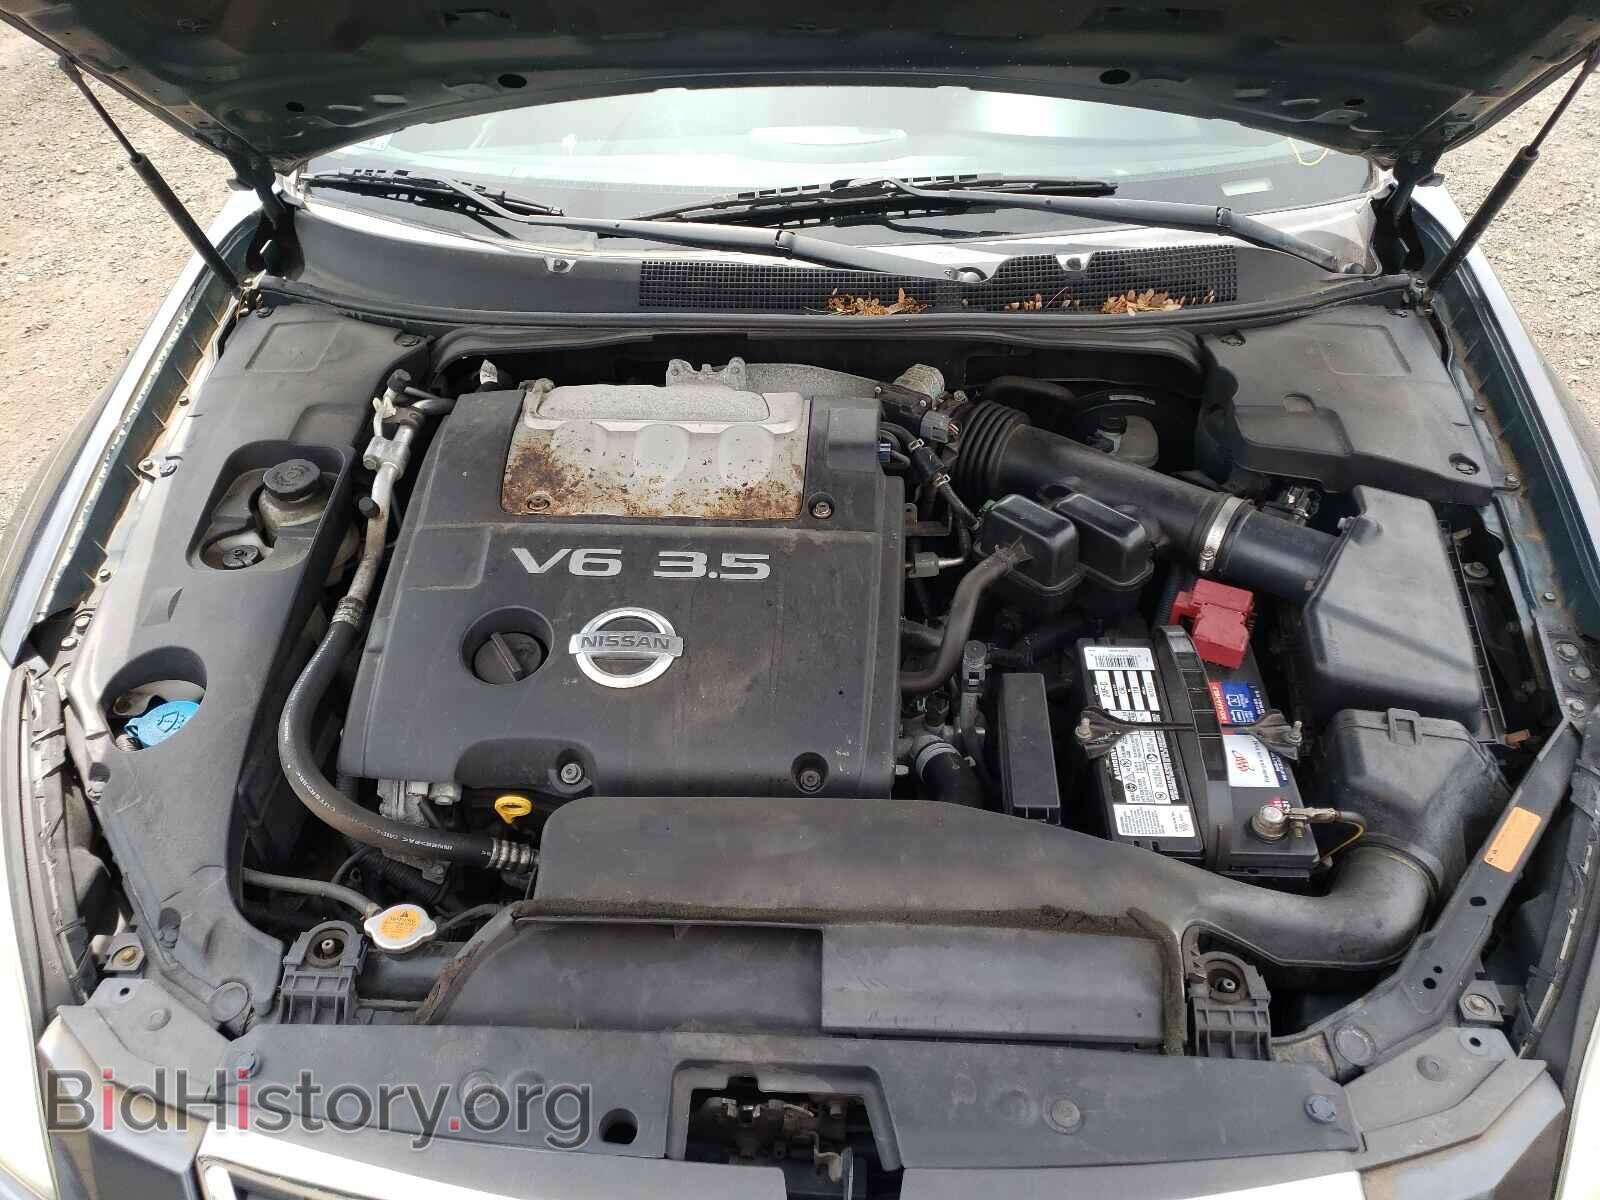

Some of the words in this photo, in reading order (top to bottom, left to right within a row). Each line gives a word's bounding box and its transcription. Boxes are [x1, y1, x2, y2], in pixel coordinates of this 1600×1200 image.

[511, 547, 622, 577] V6
[653, 551, 771, 580] 3.5
[580, 634, 670, 650] NISSAN
